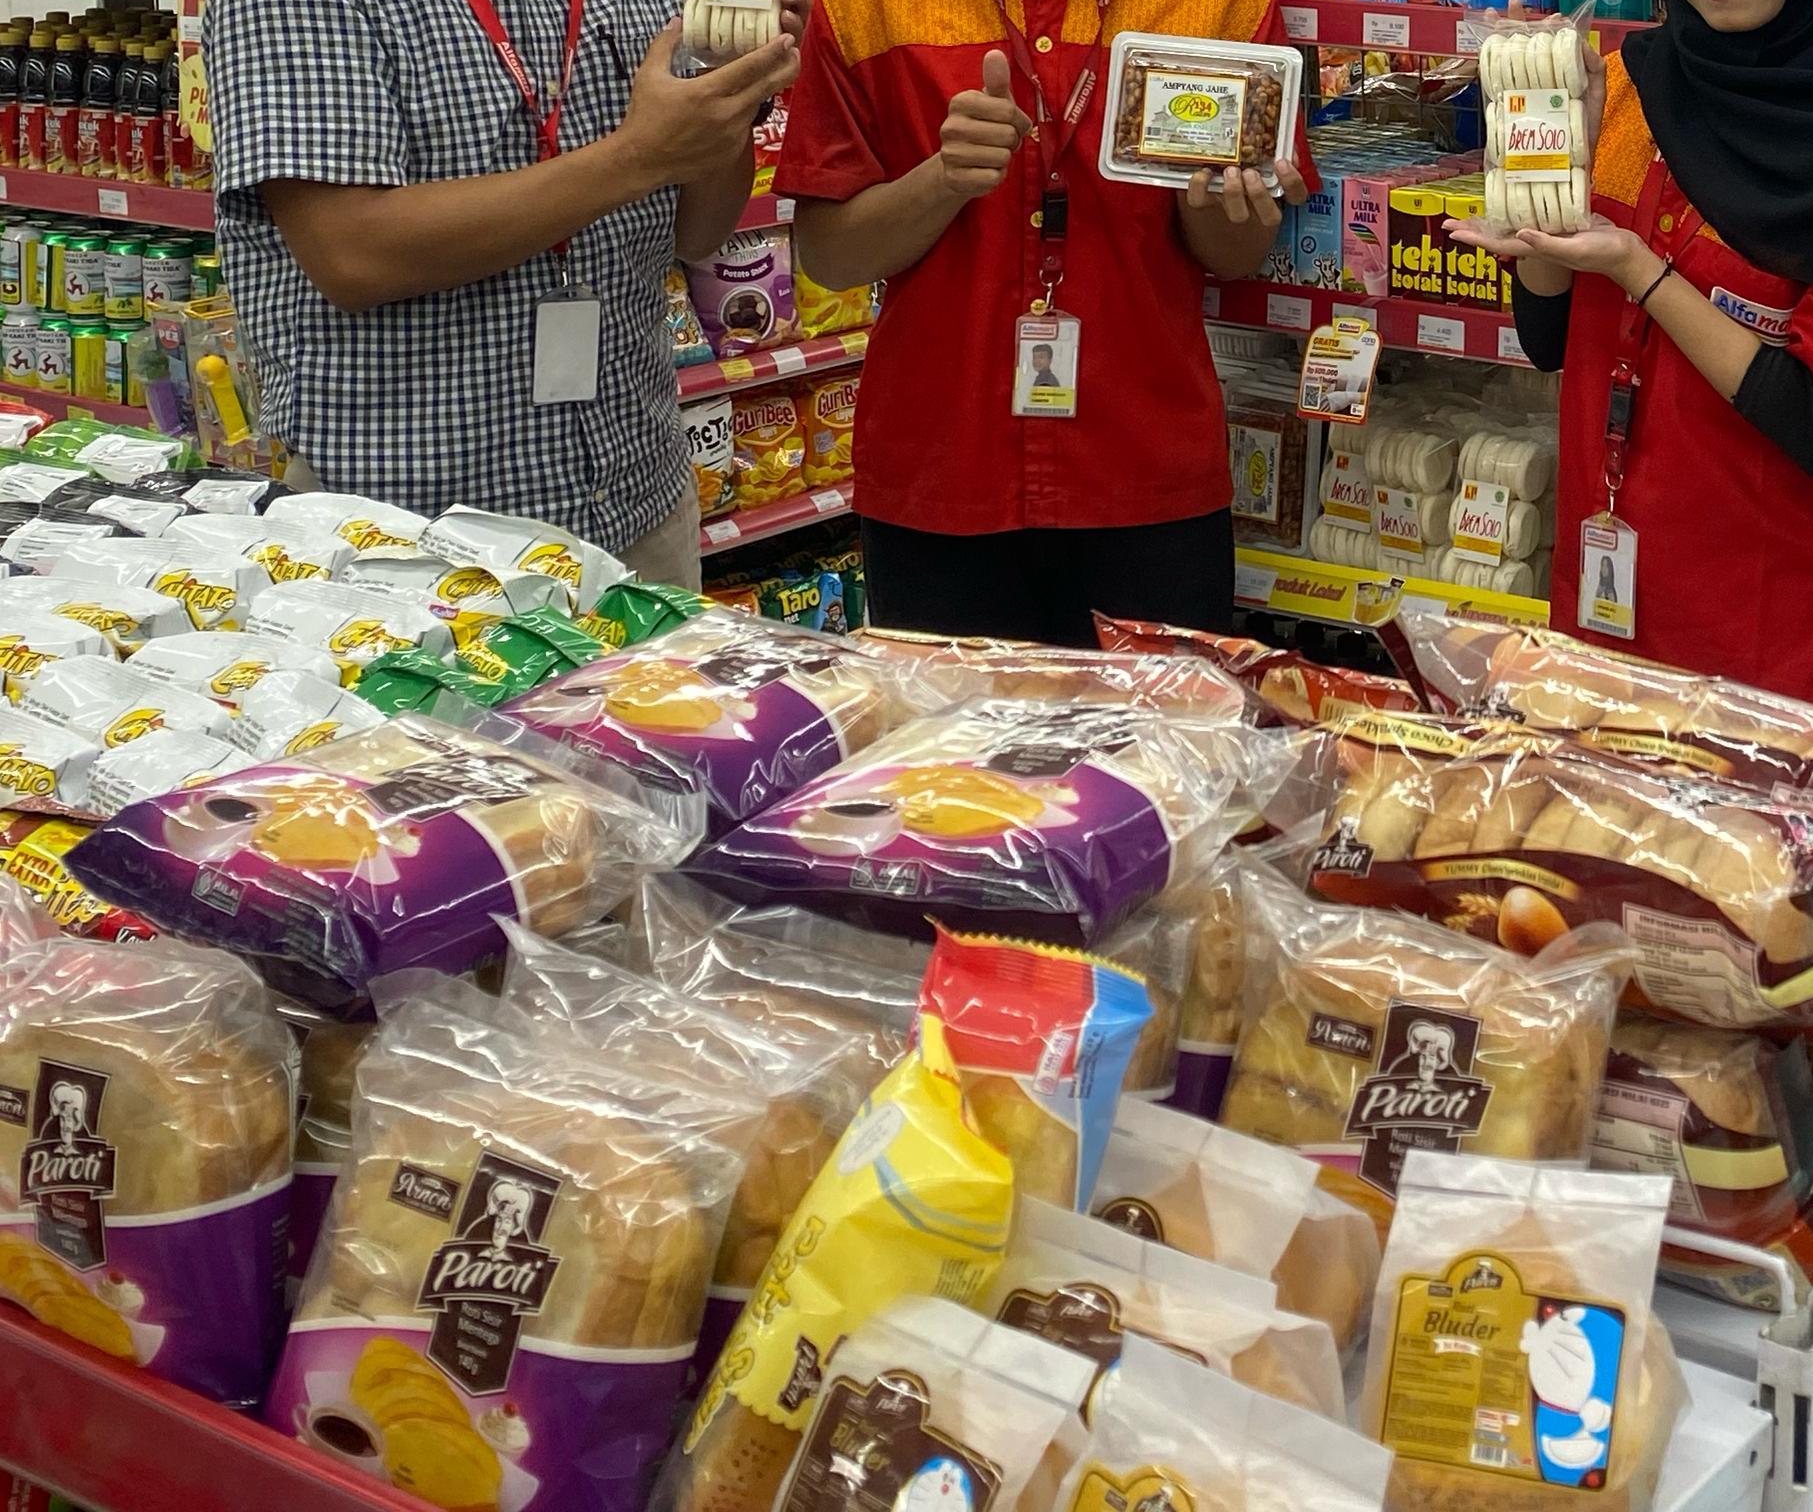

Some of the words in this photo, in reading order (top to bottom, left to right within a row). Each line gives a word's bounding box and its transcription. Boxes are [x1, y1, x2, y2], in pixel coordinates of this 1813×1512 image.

[1205, 85, 1230, 94] JAHE
[1308, 203, 1332, 217] MILK
[1351, 199, 1381, 214] ULTRA
[1353, 211, 1378, 224] MILK
[1391, 234, 1443, 274] teh
[1446, 245, 1497, 281] teh
[1391, 268, 1443, 294] kotak
[1446, 276, 1497, 301] kotak
[778, 586, 822, 620] Taro
[1443, 862, 1479, 876] YUMMY
[1361, 1082, 1478, 1123] Paroti
[27, 1150, 105, 1188] Paroti
[395, 1172, 453, 1212] Arnon
[432, 1251, 544, 1296] Paroti
[460, 1301, 482, 1320] Roti
[1423, 1310, 1500, 1340] Bluder
